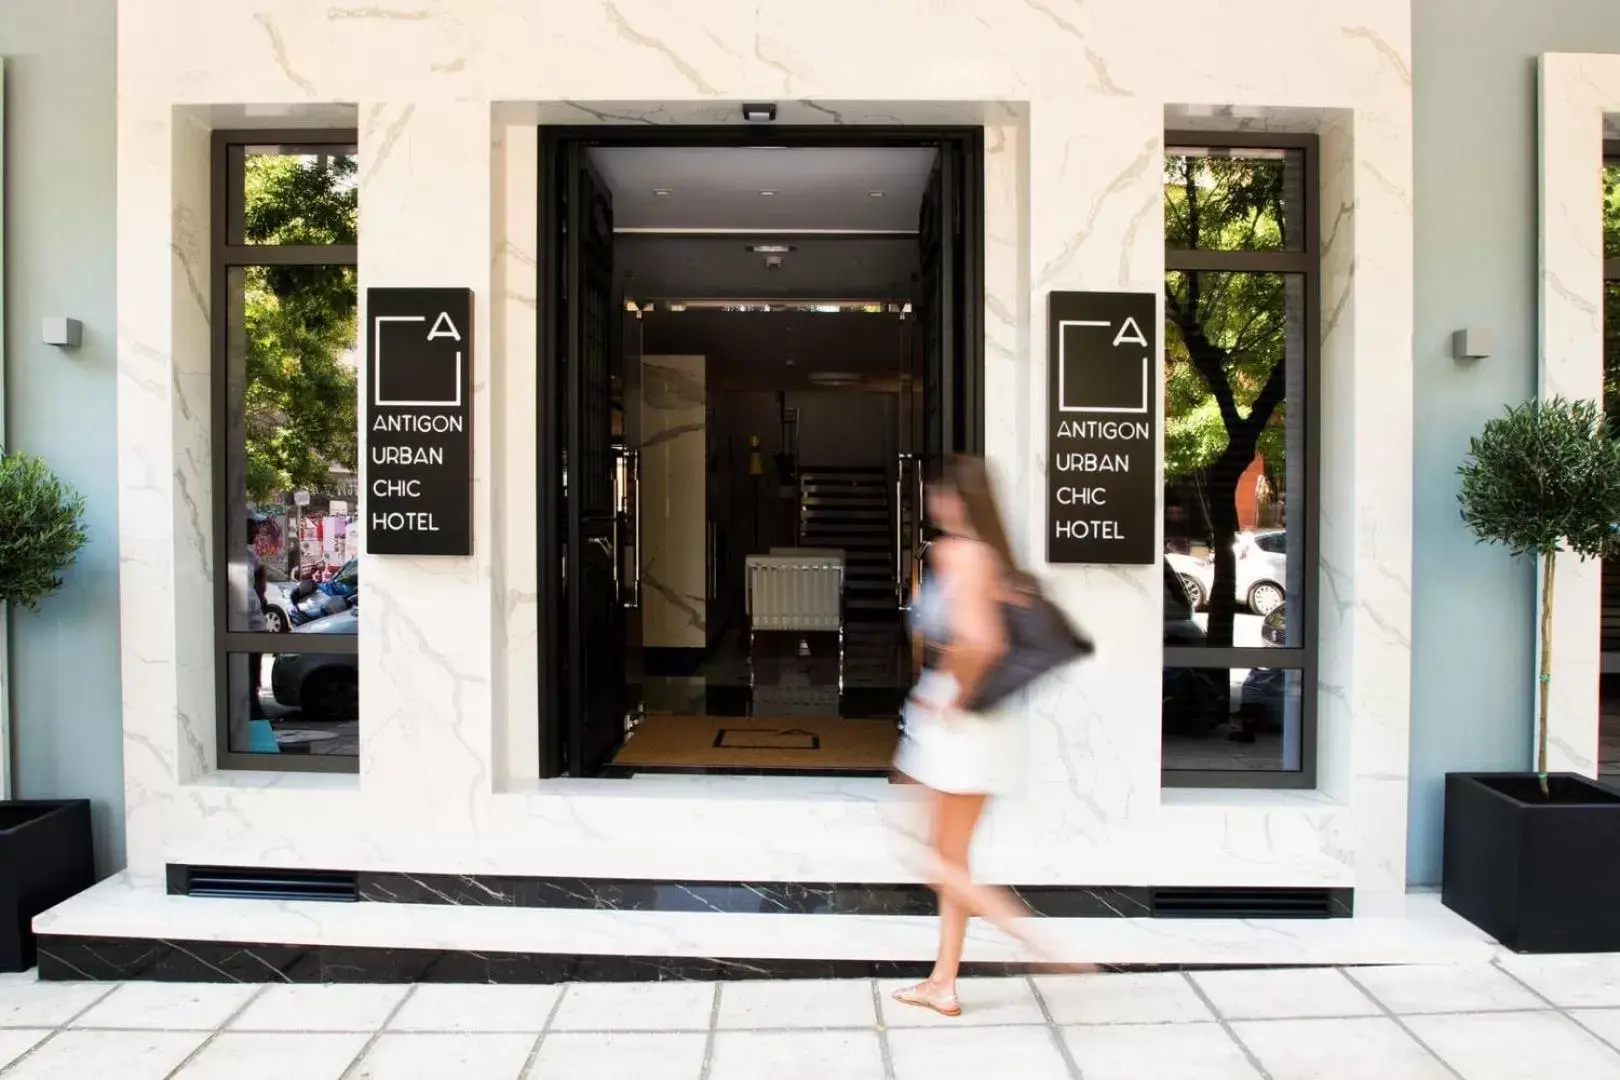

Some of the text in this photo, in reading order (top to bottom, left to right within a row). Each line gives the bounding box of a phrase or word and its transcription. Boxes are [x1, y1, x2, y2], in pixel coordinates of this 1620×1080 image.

[426, 312, 461, 342] A
[1113, 317, 1148, 347] A
[373, 415, 462, 432] ANTIGON
[1057, 421, 1149, 440] ANTIGON
[373, 447, 443, 464] URBAN
[1056, 453, 1129, 472] URBAN
[373, 480, 421, 497] CHIC
[1057, 487, 1106, 505] CHIC
[373, 512, 439, 530] HOTEL
[1056, 520, 1124, 539] HOTEL
